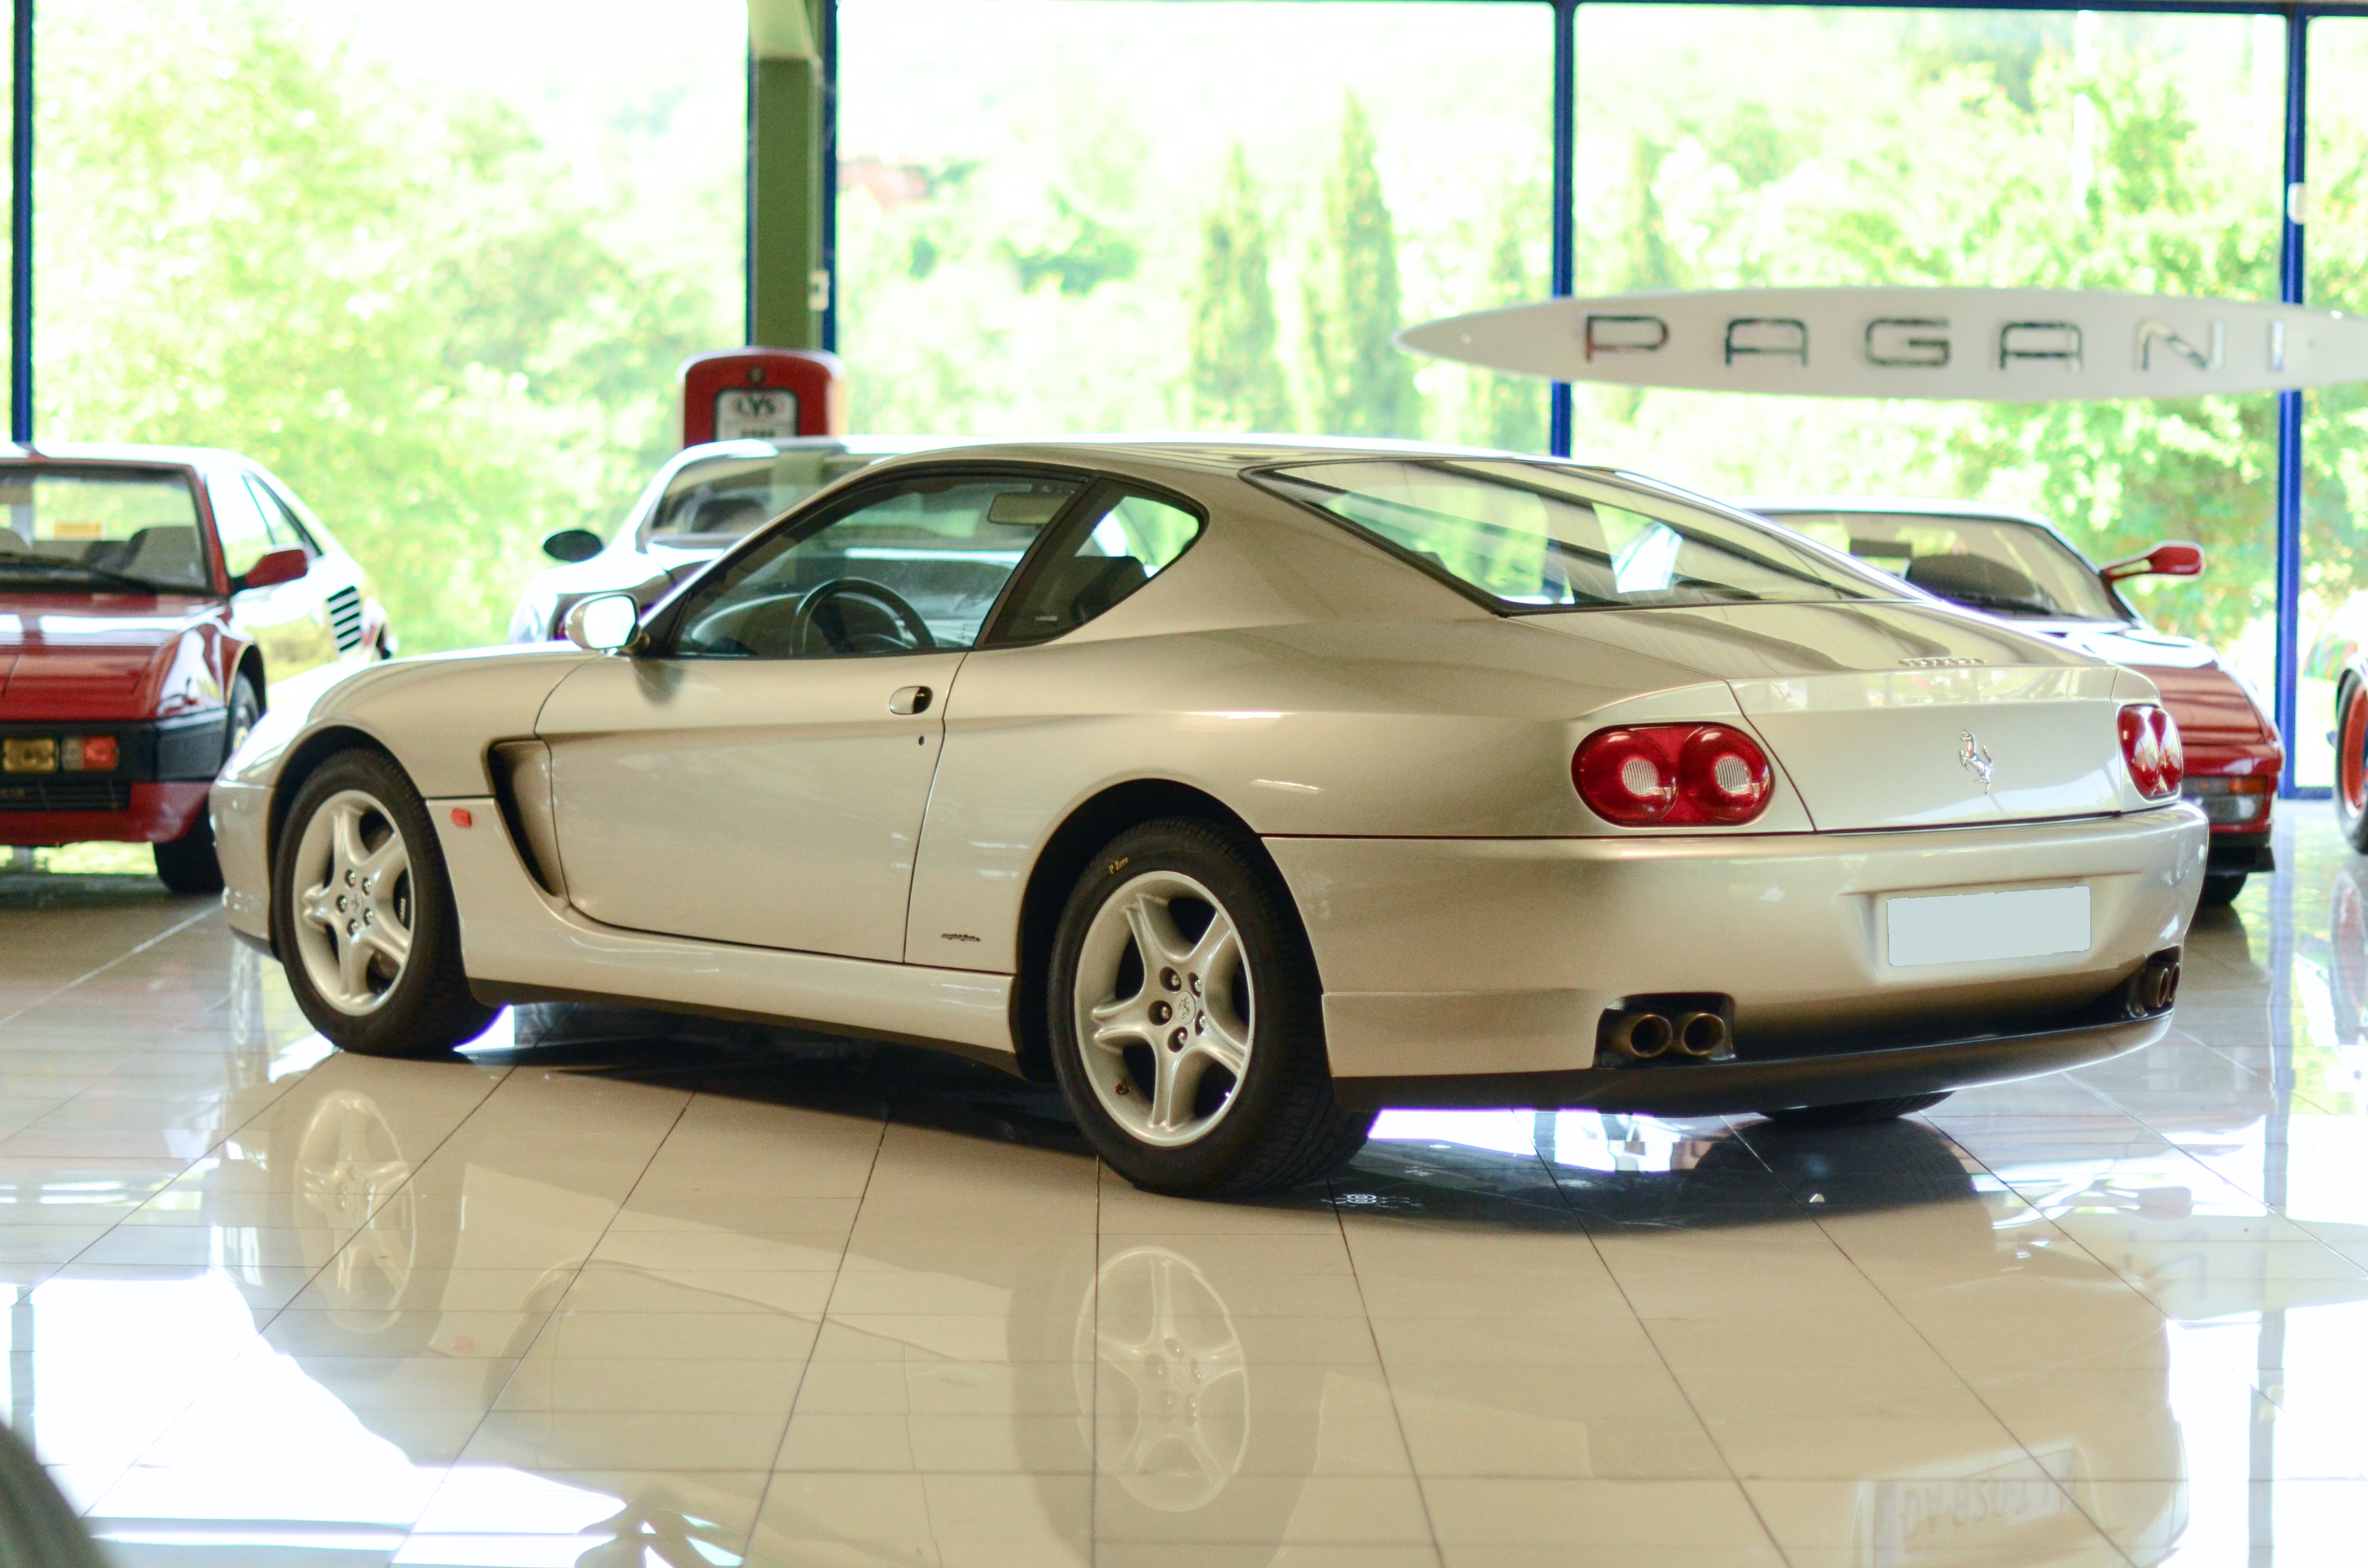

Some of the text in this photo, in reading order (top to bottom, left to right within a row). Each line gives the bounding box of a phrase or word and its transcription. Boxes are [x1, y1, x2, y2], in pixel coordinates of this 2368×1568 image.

[1584, 315, 2285, 372] PAGANI
[1109, 857, 1129, 875] P Zero
